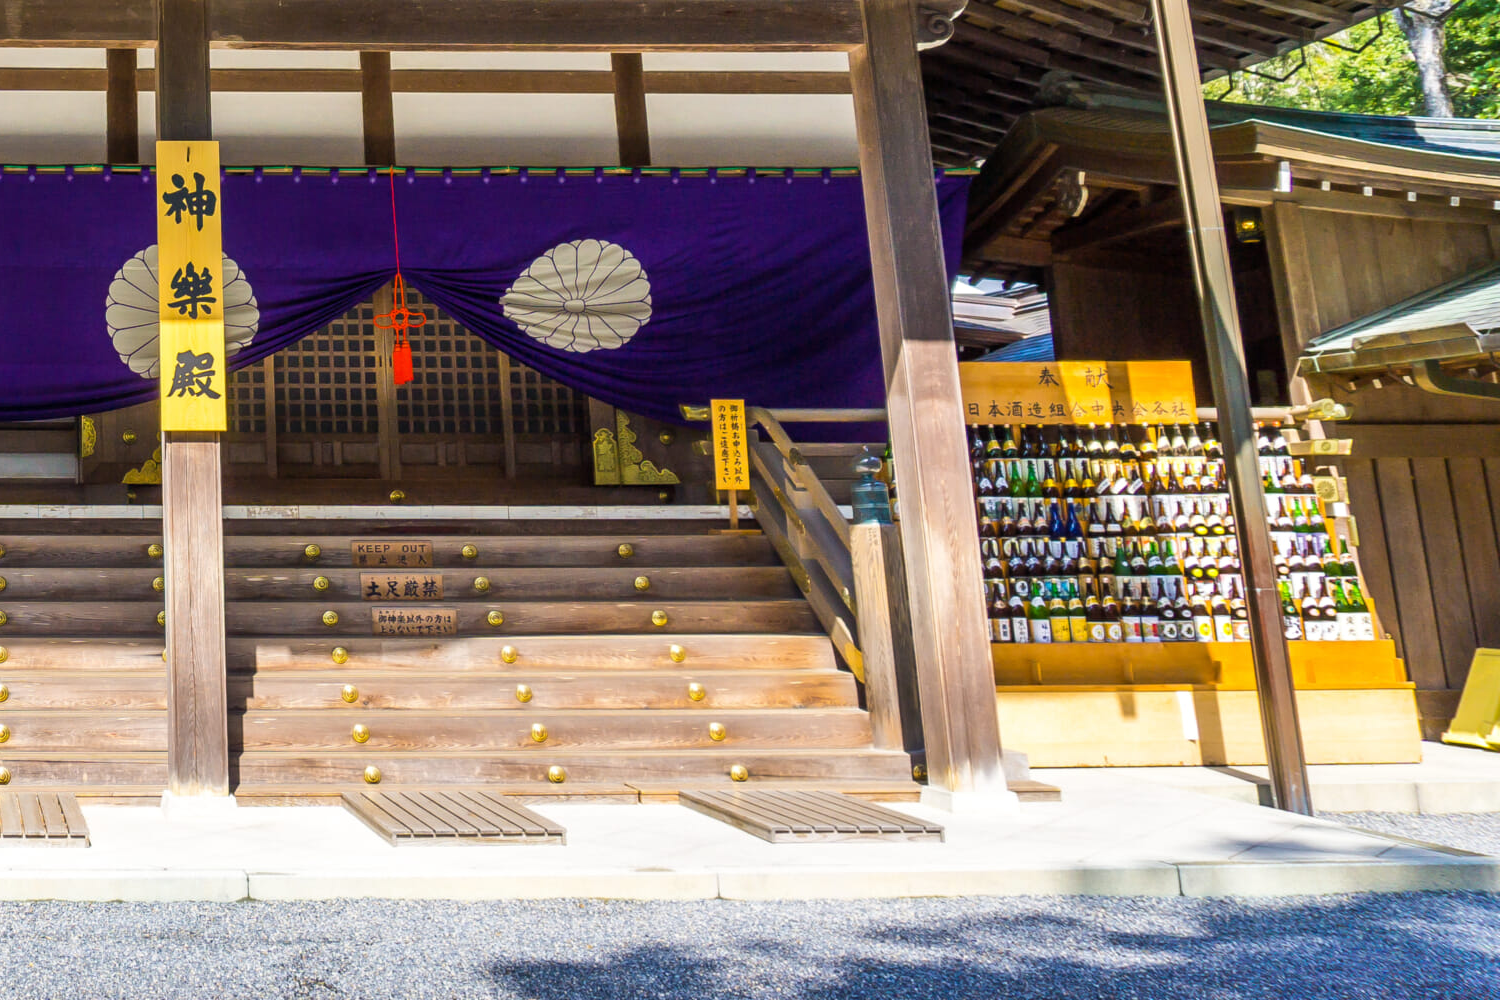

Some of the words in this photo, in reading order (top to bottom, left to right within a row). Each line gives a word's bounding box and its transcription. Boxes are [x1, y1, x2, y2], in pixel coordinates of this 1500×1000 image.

[161, 171, 222, 400] 神樂殿
[1038, 366, 1114, 389] 奉献
[967, 400, 1190, 418] 日本酒造組合中央会各社
[357, 544, 390, 553] KEEP
[402, 544, 427, 553] OUT
[366, 580, 438, 597] 土足厳禁
